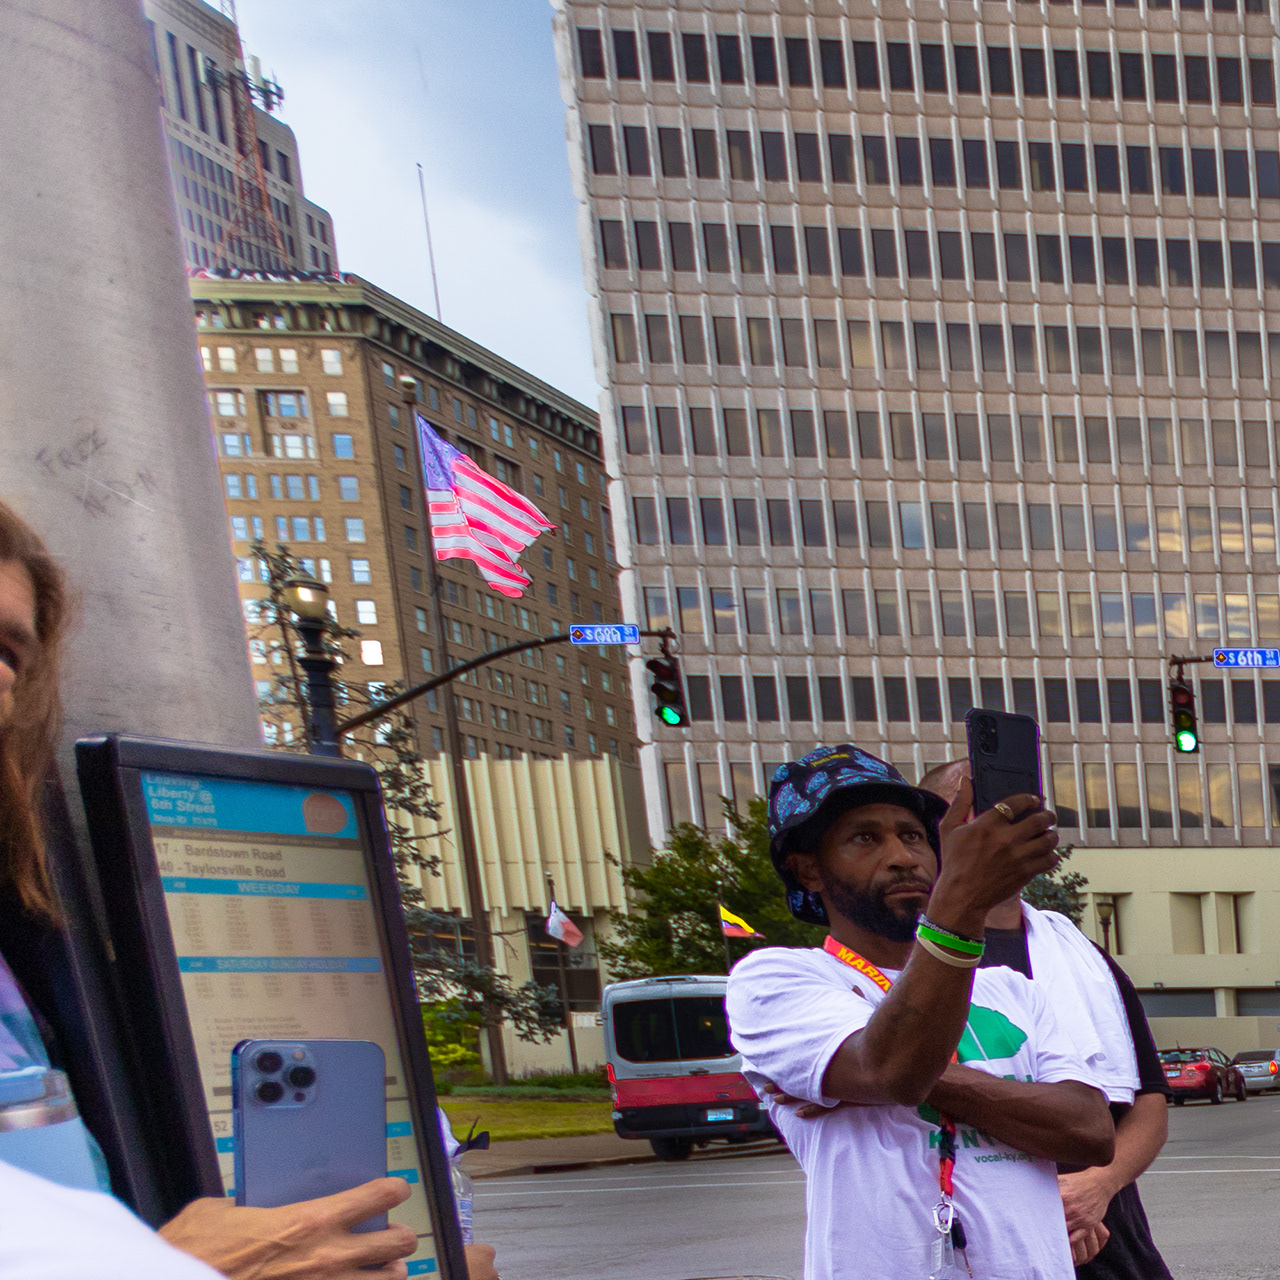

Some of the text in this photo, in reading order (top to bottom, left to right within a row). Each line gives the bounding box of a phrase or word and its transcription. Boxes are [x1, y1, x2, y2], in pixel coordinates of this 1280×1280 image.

[1228, 650, 1275, 666] S 6th St
[148, 785, 195, 801] Liberty
[151, 799, 216, 814] 6th Street
[184, 844, 249, 860] Bardstown
[252, 847, 283, 861] Road
[185, 861, 253, 878] Taylorsville
[255, 864, 286, 879] Road
[237, 881, 301, 895] WEEKDAY
[213, 1121, 228, 1132] 52
